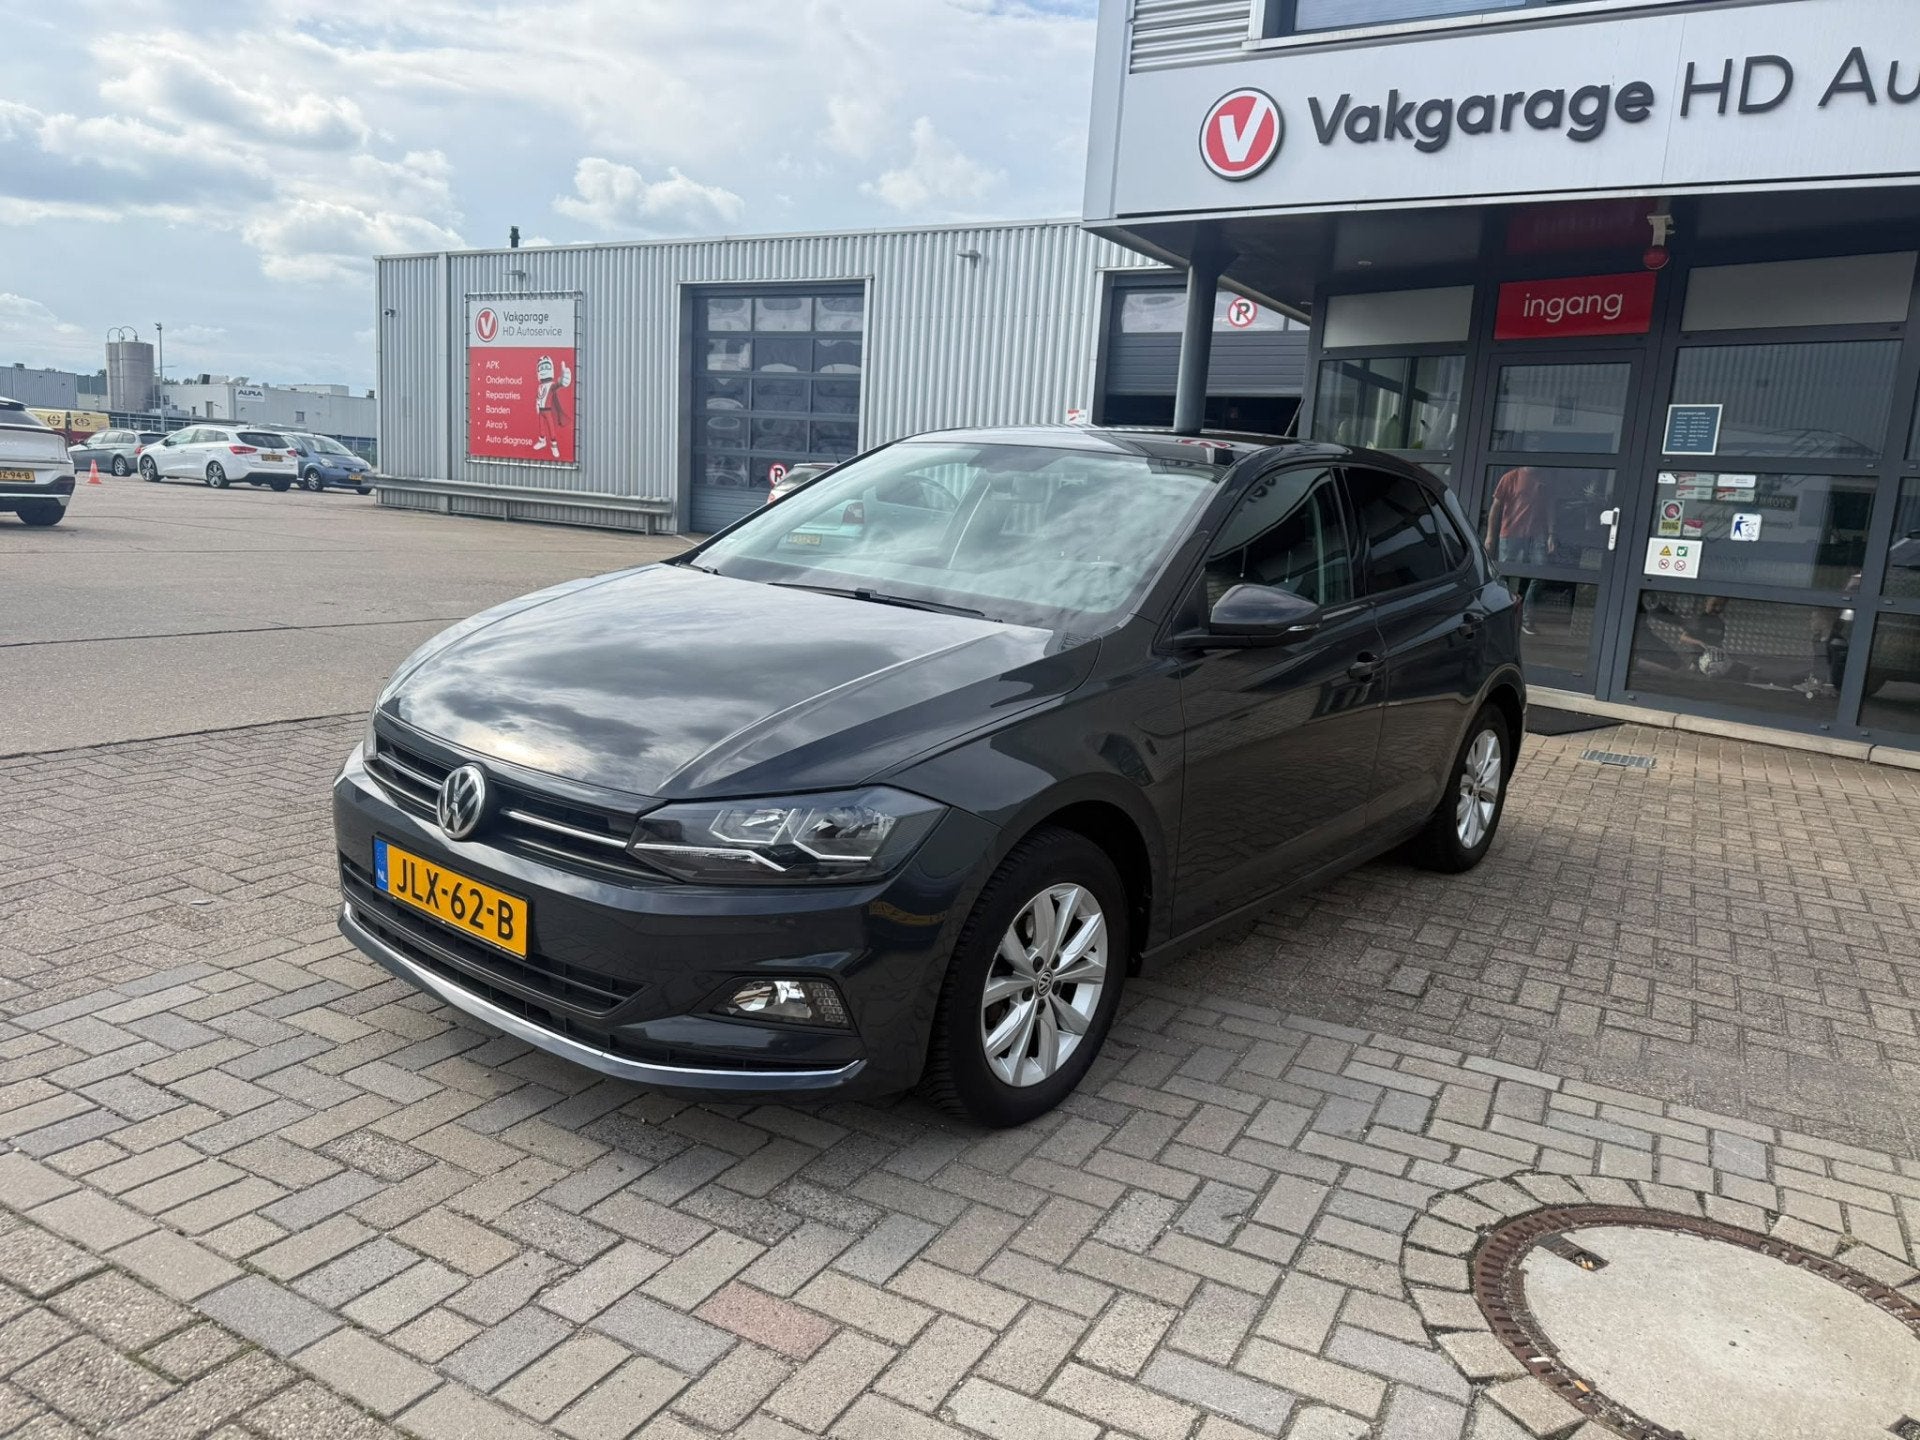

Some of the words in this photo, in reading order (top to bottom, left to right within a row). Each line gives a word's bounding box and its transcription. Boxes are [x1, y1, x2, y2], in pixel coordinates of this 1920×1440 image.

[1308, 79, 1655, 153] Vakgarage
[1680, 54, 1794, 117] HD
[1523, 293, 1623, 323] ingang
[503, 311, 549, 325] Vakgarage
[502, 326, 515, 336] HD
[516, 326, 562, 337] Autoservice
[485, 360, 500, 369] APK
[485, 375, 522, 385] Onderhoud
[485, 391, 520, 401] Reparaties
[485, 406, 511, 415] Banden
[485, 420, 508, 429] Airco's
[485, 435, 501, 444] Auto
[502, 436, 533, 447] diagnose
[397, 858, 514, 941] JLX-62-B
